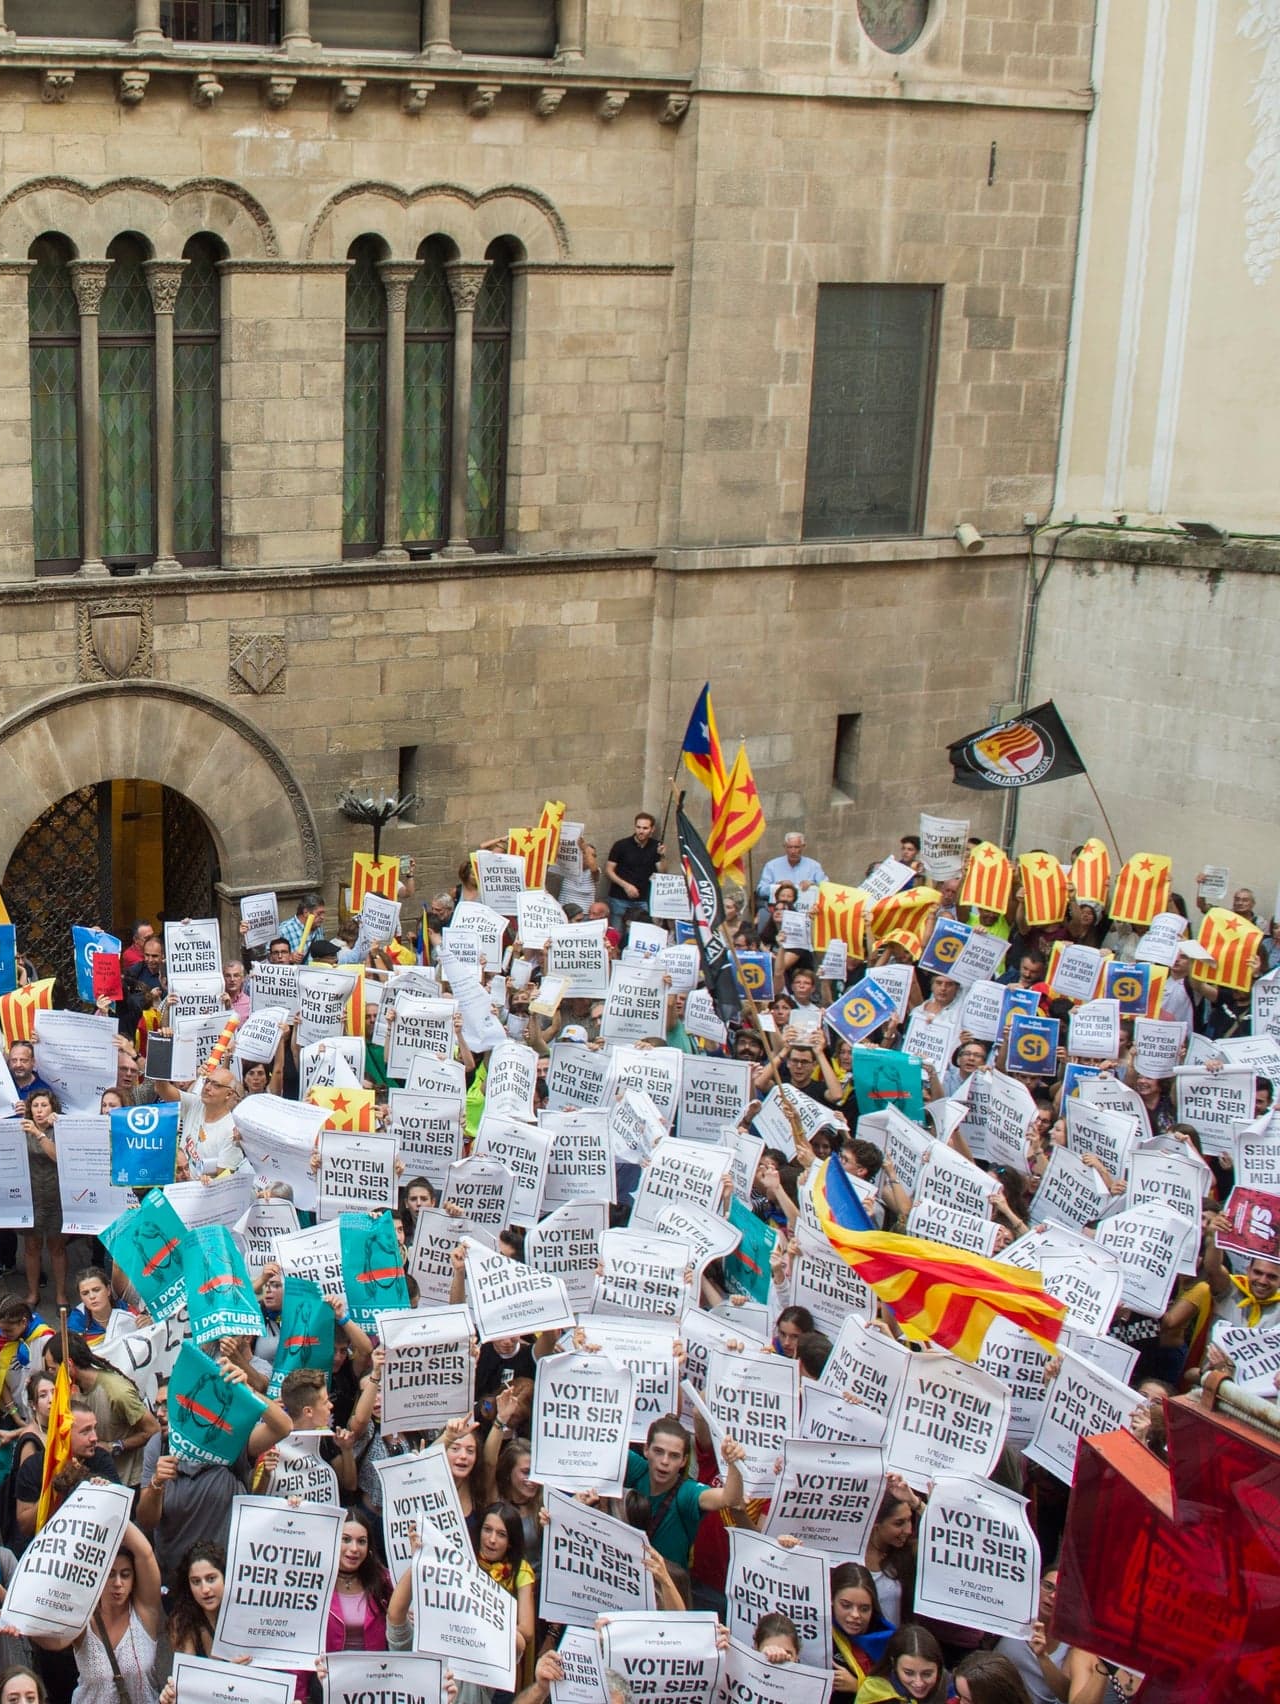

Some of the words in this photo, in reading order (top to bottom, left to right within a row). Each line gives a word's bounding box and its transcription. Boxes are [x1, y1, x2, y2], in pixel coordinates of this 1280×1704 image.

[175, 942, 211, 950] VOTEM
[558, 938, 598, 949] VOTEM
[171, 952, 193, 961] PER
[198, 951, 215, 960] SER
[553, 950, 575, 959] PER
[579, 950, 601, 959] SER
[172, 962, 215, 972] LLIURES
[554, 961, 601, 970] LLIURES
[401, 1018, 445, 1029] VOTEM
[397, 1027, 421, 1037] PER
[425, 1031, 448, 1041] SER
[397, 1037, 446, 1053] LLIURES
[691, 1080, 738, 1094] VOTEM
[1190, 1086, 1242, 1099] VOTEM
[686, 1092, 711, 1104] PER
[716, 1098, 741, 1109] SER
[1185, 1097, 1211, 1109] PER
[1217, 1101, 1246, 1113] SER
[686, 1104, 741, 1119] LLIURES
[126, 1137, 163, 1149] VULL!
[396, 1342, 458, 1359] VOTEM
[387, 1360, 423, 1375] PER
[428, 1355, 464, 1370] SER
[389, 1372, 463, 1389] LLIURES
[551, 1382, 619, 1404] VOTEM
[918, 1380, 991, 1416] VOTEM
[542, 1403, 576, 1420] PER
[586, 1408, 623, 1425] SER
[905, 1395, 944, 1421] PER
[950, 1411, 994, 1439] SER
[543, 1421, 618, 1443] LLIURES
[902, 1416, 988, 1455] LLIURES
[796, 1473, 868, 1492] VOTEM
[784, 1492, 821, 1507] PER
[829, 1493, 869, 1509] SER
[779, 1507, 863, 1523] LLIURES
[940, 1507, 1019, 1541] VOTEM
[42, 1521, 109, 1544] VOTEM
[28, 1540, 66, 1559] PER
[73, 1541, 106, 1566] SER
[562, 1523, 633, 1564] VOTEM
[931, 1526, 973, 1548] PER
[982, 1540, 1027, 1563] SER
[250, 1542, 321, 1567] VOTEM
[554, 1536, 594, 1559] PER
[601, 1552, 640, 1582] SER
[931, 1546, 1025, 1583] LLIURES
[24, 1558, 98, 1588] LLIURES
[239, 1564, 277, 1584] PER
[284, 1570, 324, 1590] SER
[554, 1557, 640, 1596] LLIURES
[235, 1588, 317, 1611] LLIURES
[422, 1565, 463, 1587] PER
[470, 1582, 505, 1617] SER
[424, 1589, 505, 1631] LLIURES
